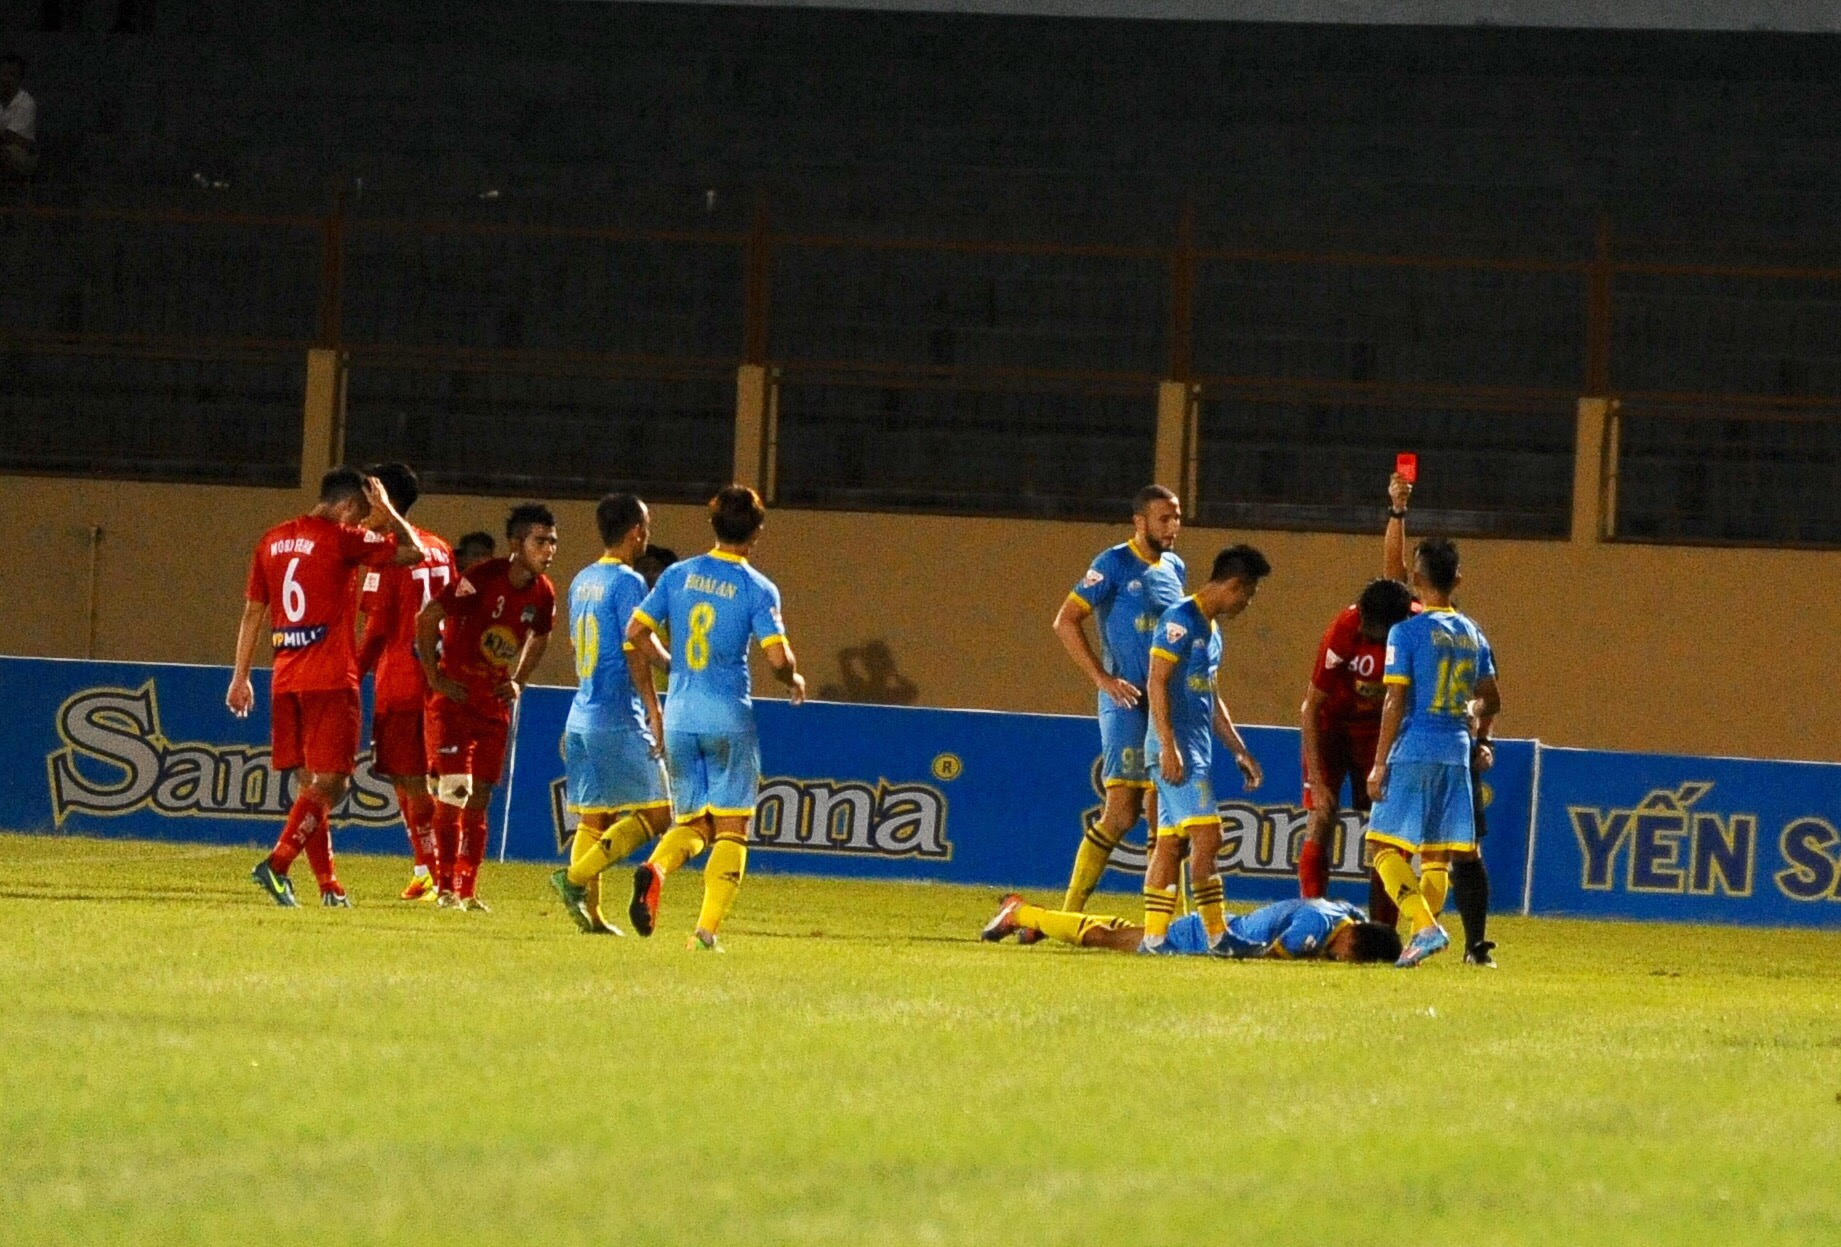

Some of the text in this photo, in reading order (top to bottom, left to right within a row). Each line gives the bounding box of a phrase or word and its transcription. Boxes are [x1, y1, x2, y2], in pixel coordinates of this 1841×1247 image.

[282, 557, 306, 622] 6
[411, 565, 450, 616] 77
[491, 595, 505, 619] 3
[685, 602, 716, 672] 8
[47, 677, 442, 829] Sans
[1567, 781, 1841, 901] YẾN S
